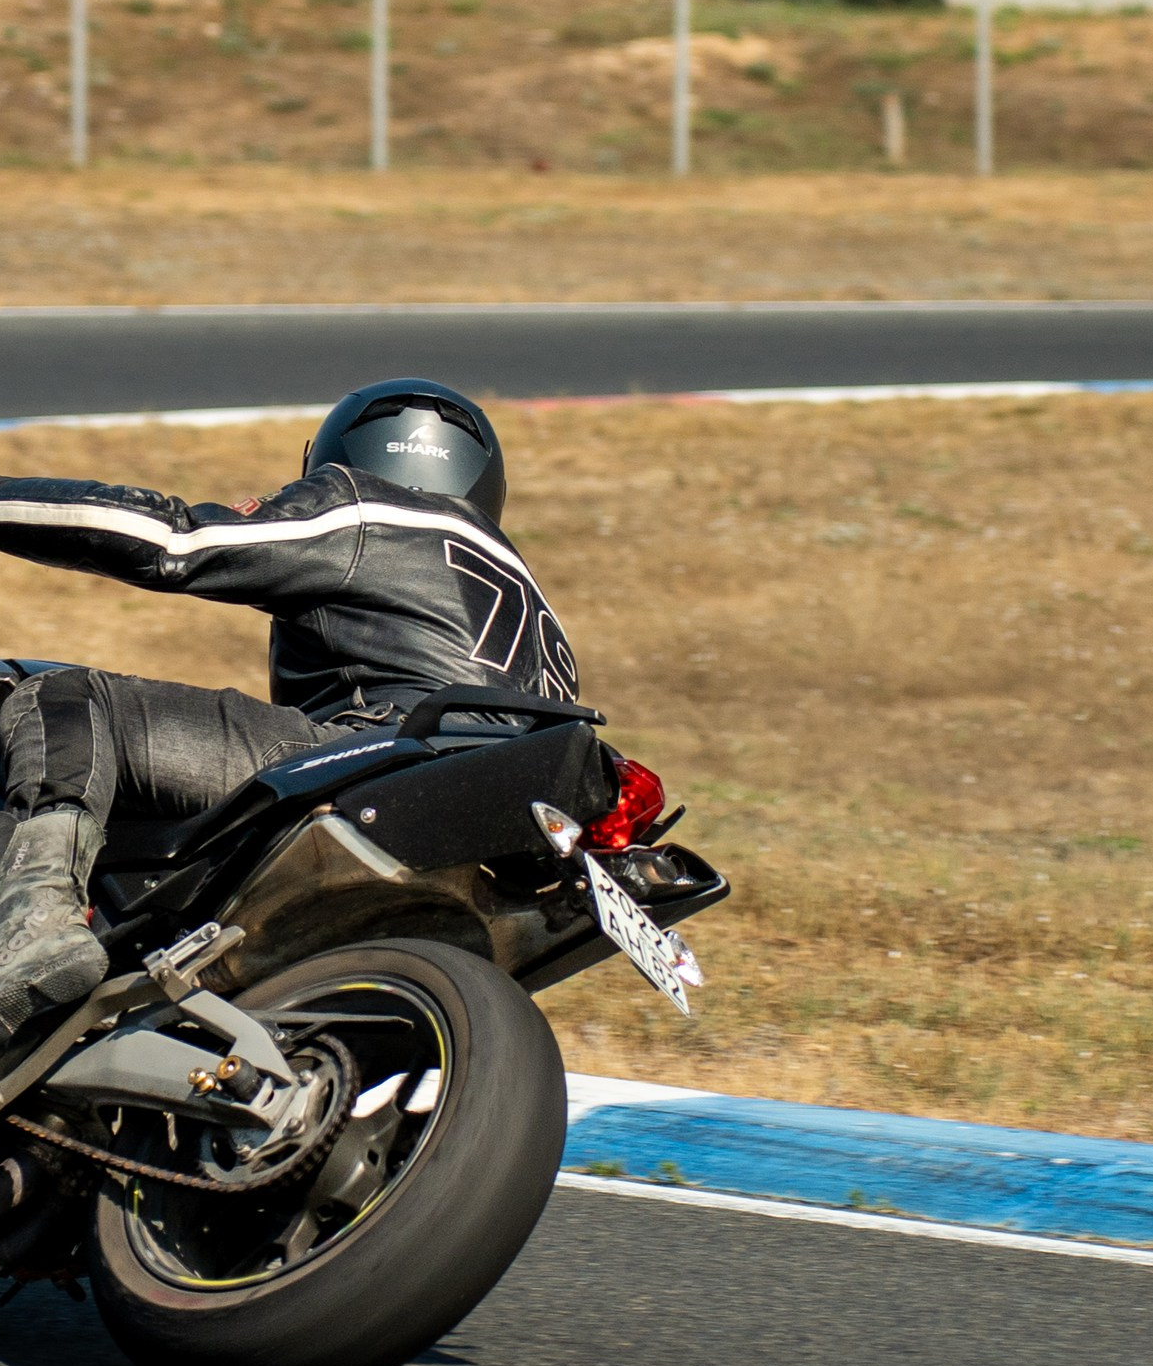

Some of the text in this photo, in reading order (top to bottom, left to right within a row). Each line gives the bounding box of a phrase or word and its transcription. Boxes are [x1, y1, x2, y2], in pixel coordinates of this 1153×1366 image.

[386, 441, 450, 460] SHARK
[601, 873, 666, 958] 2022
[652, 956, 684, 1005] 82
